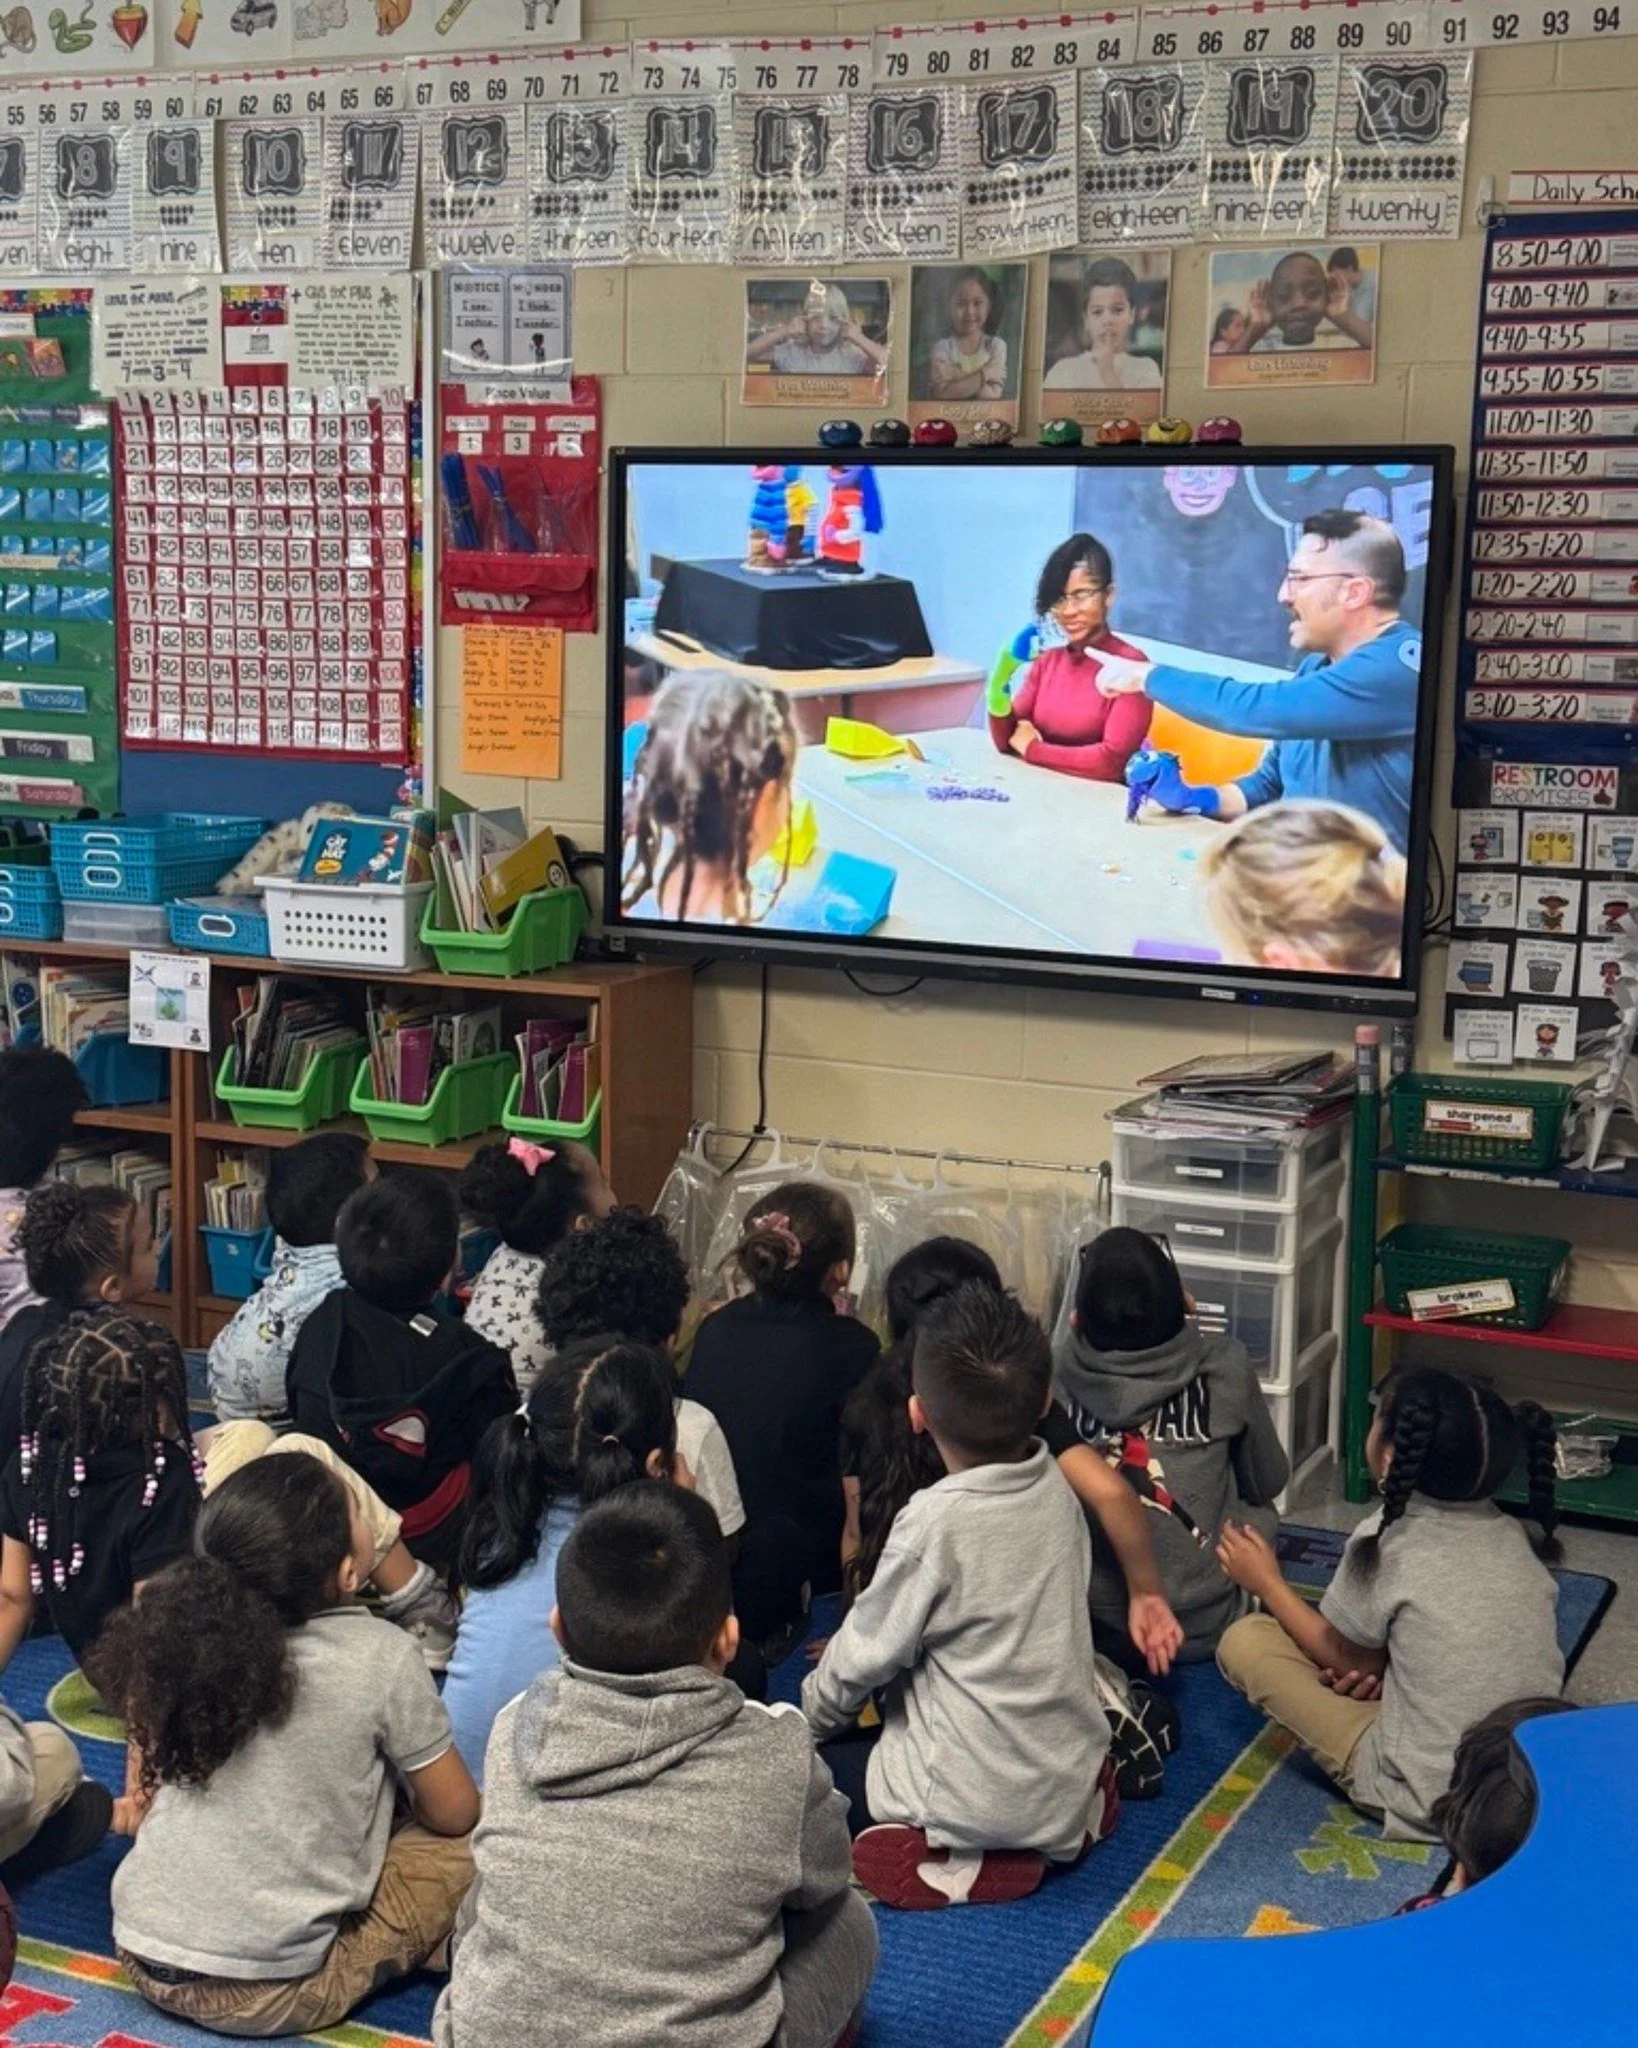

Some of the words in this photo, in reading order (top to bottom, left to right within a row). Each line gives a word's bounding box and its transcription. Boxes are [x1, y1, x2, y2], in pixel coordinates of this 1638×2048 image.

[1444, 18, 1466, 43] 91
[1493, 15, 1519, 39] 92
[1543, 11, 1569, 36] 93
[1594, 7, 1619, 32] 94
[1152, 34, 1176, 55] 85
[1198, 31, 1222, 54] 86
[1244, 29, 1269, 52] 87
[1290, 26, 1315, 49] 88
[1337, 23, 1363, 48] 89
[1386, 22, 1411, 46] 90
[887, 53, 908, 76] 79
[928, 51, 949, 74] 80
[969, 49, 989, 71] 81
[1011, 45, 1034, 68] 82
[1054, 42, 1077, 65] 83
[1097, 39, 1120, 61] 84
[417, 83, 433, 105] 67
[450, 81, 470, 103] 68
[487, 79, 506, 100] 69
[525, 77, 544, 98] 70
[562, 75, 578, 95] 71
[599, 71, 618, 94] 72
[644, 67, 663, 89] 73
[682, 68, 700, 89] 74
[718, 67, 736, 89] 75
[755, 66, 777, 88] 76
[797, 66, 818, 88] 77
[838, 65, 859, 87] 78
[8, 106, 24, 125] 55
[39, 104, 56, 124] 56
[70, 103, 87, 122] 57
[102, 101, 120, 121] 58
[135, 100, 152, 120] 59
[166, 98, 183, 118] 60
[205, 98, 222, 117] 61
[239, 96, 258, 115] 62
[273, 94, 291, 113] 63
[307, 91, 325, 112] 64
[341, 89, 358, 109] 65
[375, 86, 393, 107] 66
[1247, 80, 1294, 130] 19
[1368, 78, 1434, 128] 20
[883, 111, 922, 156] 16
[998, 102, 1038, 149] 17
[457, 128, 500, 171] 12
[662, 120, 699, 162] 14
[74, 146, 98, 186] 8
[165, 141, 186, 181] 9
[256, 139, 291, 184] 10
[1533, 175, 1584, 204] Daily
[1093, 204, 1189, 236] eighteen
[1214, 197, 1311, 222] nineteen
[1346, 199, 1440, 230] twenty
[439, 230, 515, 254] twelve
[544, 227, 618, 249] thirteen
[637, 226, 721, 248] fourteen
[862, 221, 941, 244] sixteen
[64, 241, 113, 266] eight
[160, 237, 197, 261] nine
[258, 244, 295, 264] ten
[339, 236, 401, 257] eleven
[121, 365, 131, 383] 7
[153, 365, 164, 382] 3
[181, 358, 192, 380] 4
[125, 392, 132, 406] 1
[154, 391, 164, 408] 2
[183, 391, 194, 408] 3
[241, 390, 252, 405] 5
[269, 390, 277, 406] 6
[126, 420, 143, 436] 11
[236, 421, 255, 438] 15
[321, 420, 338, 437] 18
[351, 420, 369, 437] 19
[1490, 410, 1594, 434] 11:00-11:30
[513, 437, 521, 449] 3
[128, 449, 145, 465] 21
[292, 450, 310, 467] 27
[318, 450, 338, 467] 28
[1479, 451, 1588, 477] 11:35-11:50
[235, 482, 254, 499] 35
[319, 481, 340, 499] 38
[1481, 490, 1590, 518] 11:50-12:30
[128, 511, 145, 526] 41
[319, 513, 341, 531] 48
[350, 514, 369, 531] 49
[130, 538, 146, 555] 51
[160, 540, 177, 557] 52
[186, 542, 205, 559] 53
[237, 542, 256, 559] 55
[263, 544, 282, 561] 56
[291, 544, 309, 561] 57
[320, 544, 340, 561] 58
[1475, 533, 1584, 558] 12:35-1:20
[127, 569, 145, 585] 61
[266, 575, 284, 591] 66
[291, 575, 310, 591] 67
[319, 574, 339, 591] 68
[1478, 573, 1577, 598] 1:20-2:20
[131, 597, 147, 614] 71
[238, 603, 256, 621] 75
[266, 603, 285, 622] 76
[293, 605, 312, 621] 77
[321, 606, 341, 623] 78
[350, 606, 369, 623] 79
[134, 624, 152, 643] 81
[186, 632, 205, 648] 83
[132, 657, 149, 673] 91
[187, 661, 205, 678] 93
[241, 663, 258, 680] 95
[269, 664, 288, 680] 96
[295, 664, 314, 681] 97
[322, 666, 341, 682] 98
[26, 691, 77, 706] Thursday
[18, 741, 51, 757] Friday
[1494, 766, 1615, 788] RESTROOM
[25, 788, 77, 801] Saturday
[1492, 788, 1590, 805] PROMISES
[1446, 1109, 1513, 1124] sharpened
[1438, 1289, 1483, 1302] broken
